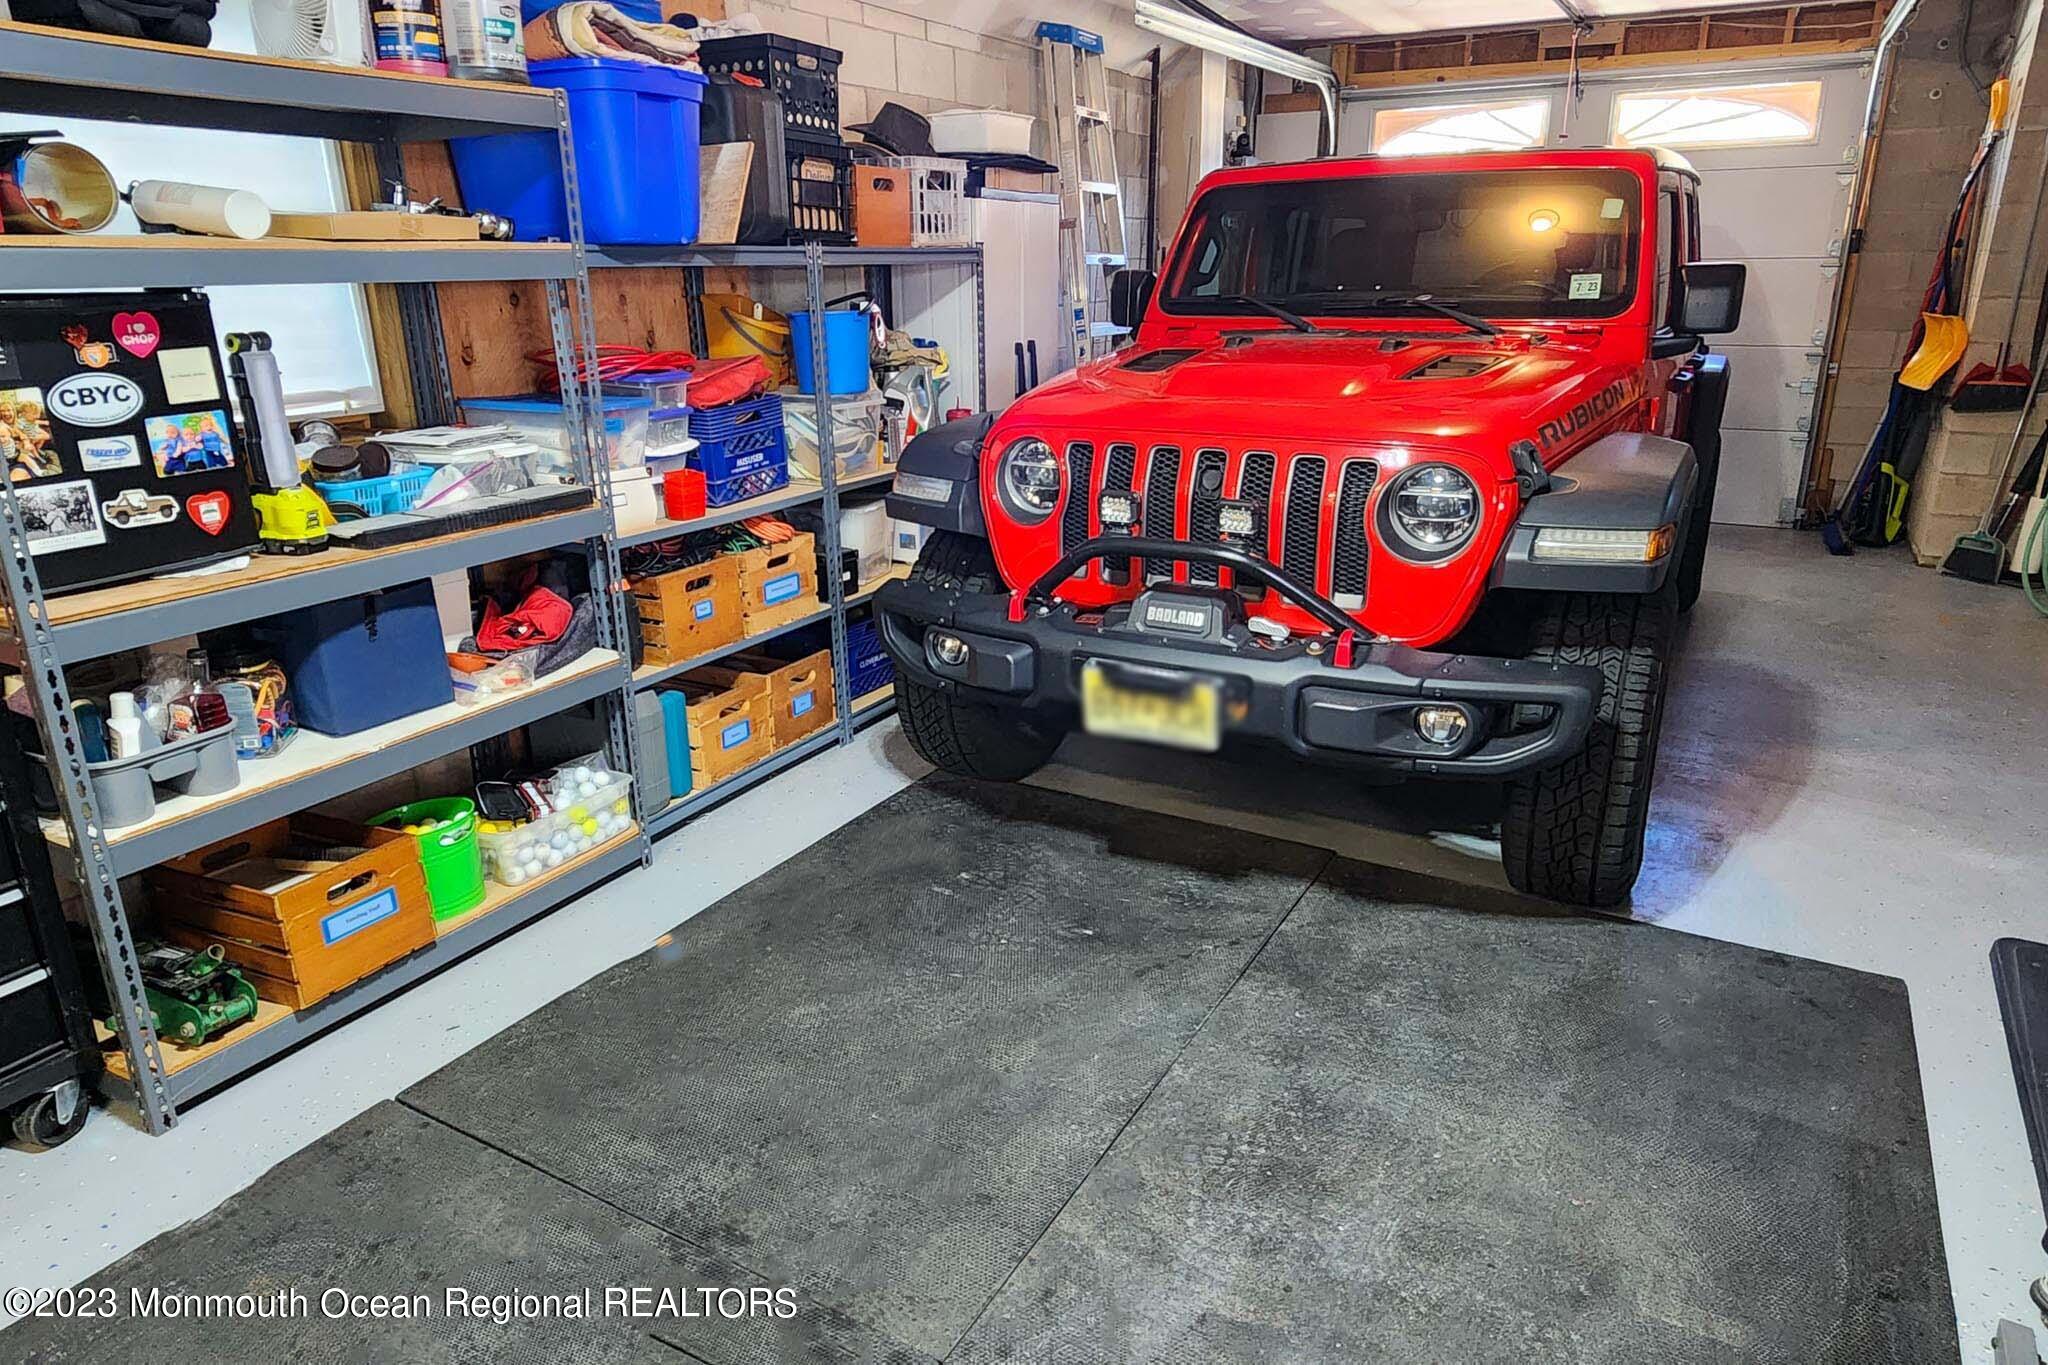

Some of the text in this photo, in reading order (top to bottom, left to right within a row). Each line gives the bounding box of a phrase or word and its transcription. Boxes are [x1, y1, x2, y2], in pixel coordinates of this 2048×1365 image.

[1576, 282, 1598, 292] 7 23
[121, 332, 157, 347] CHOP
[58, 383, 132, 408] CBYC
[1537, 381, 1625, 448] RUBICON
[1146, 606, 1206, 627] BADLAND
